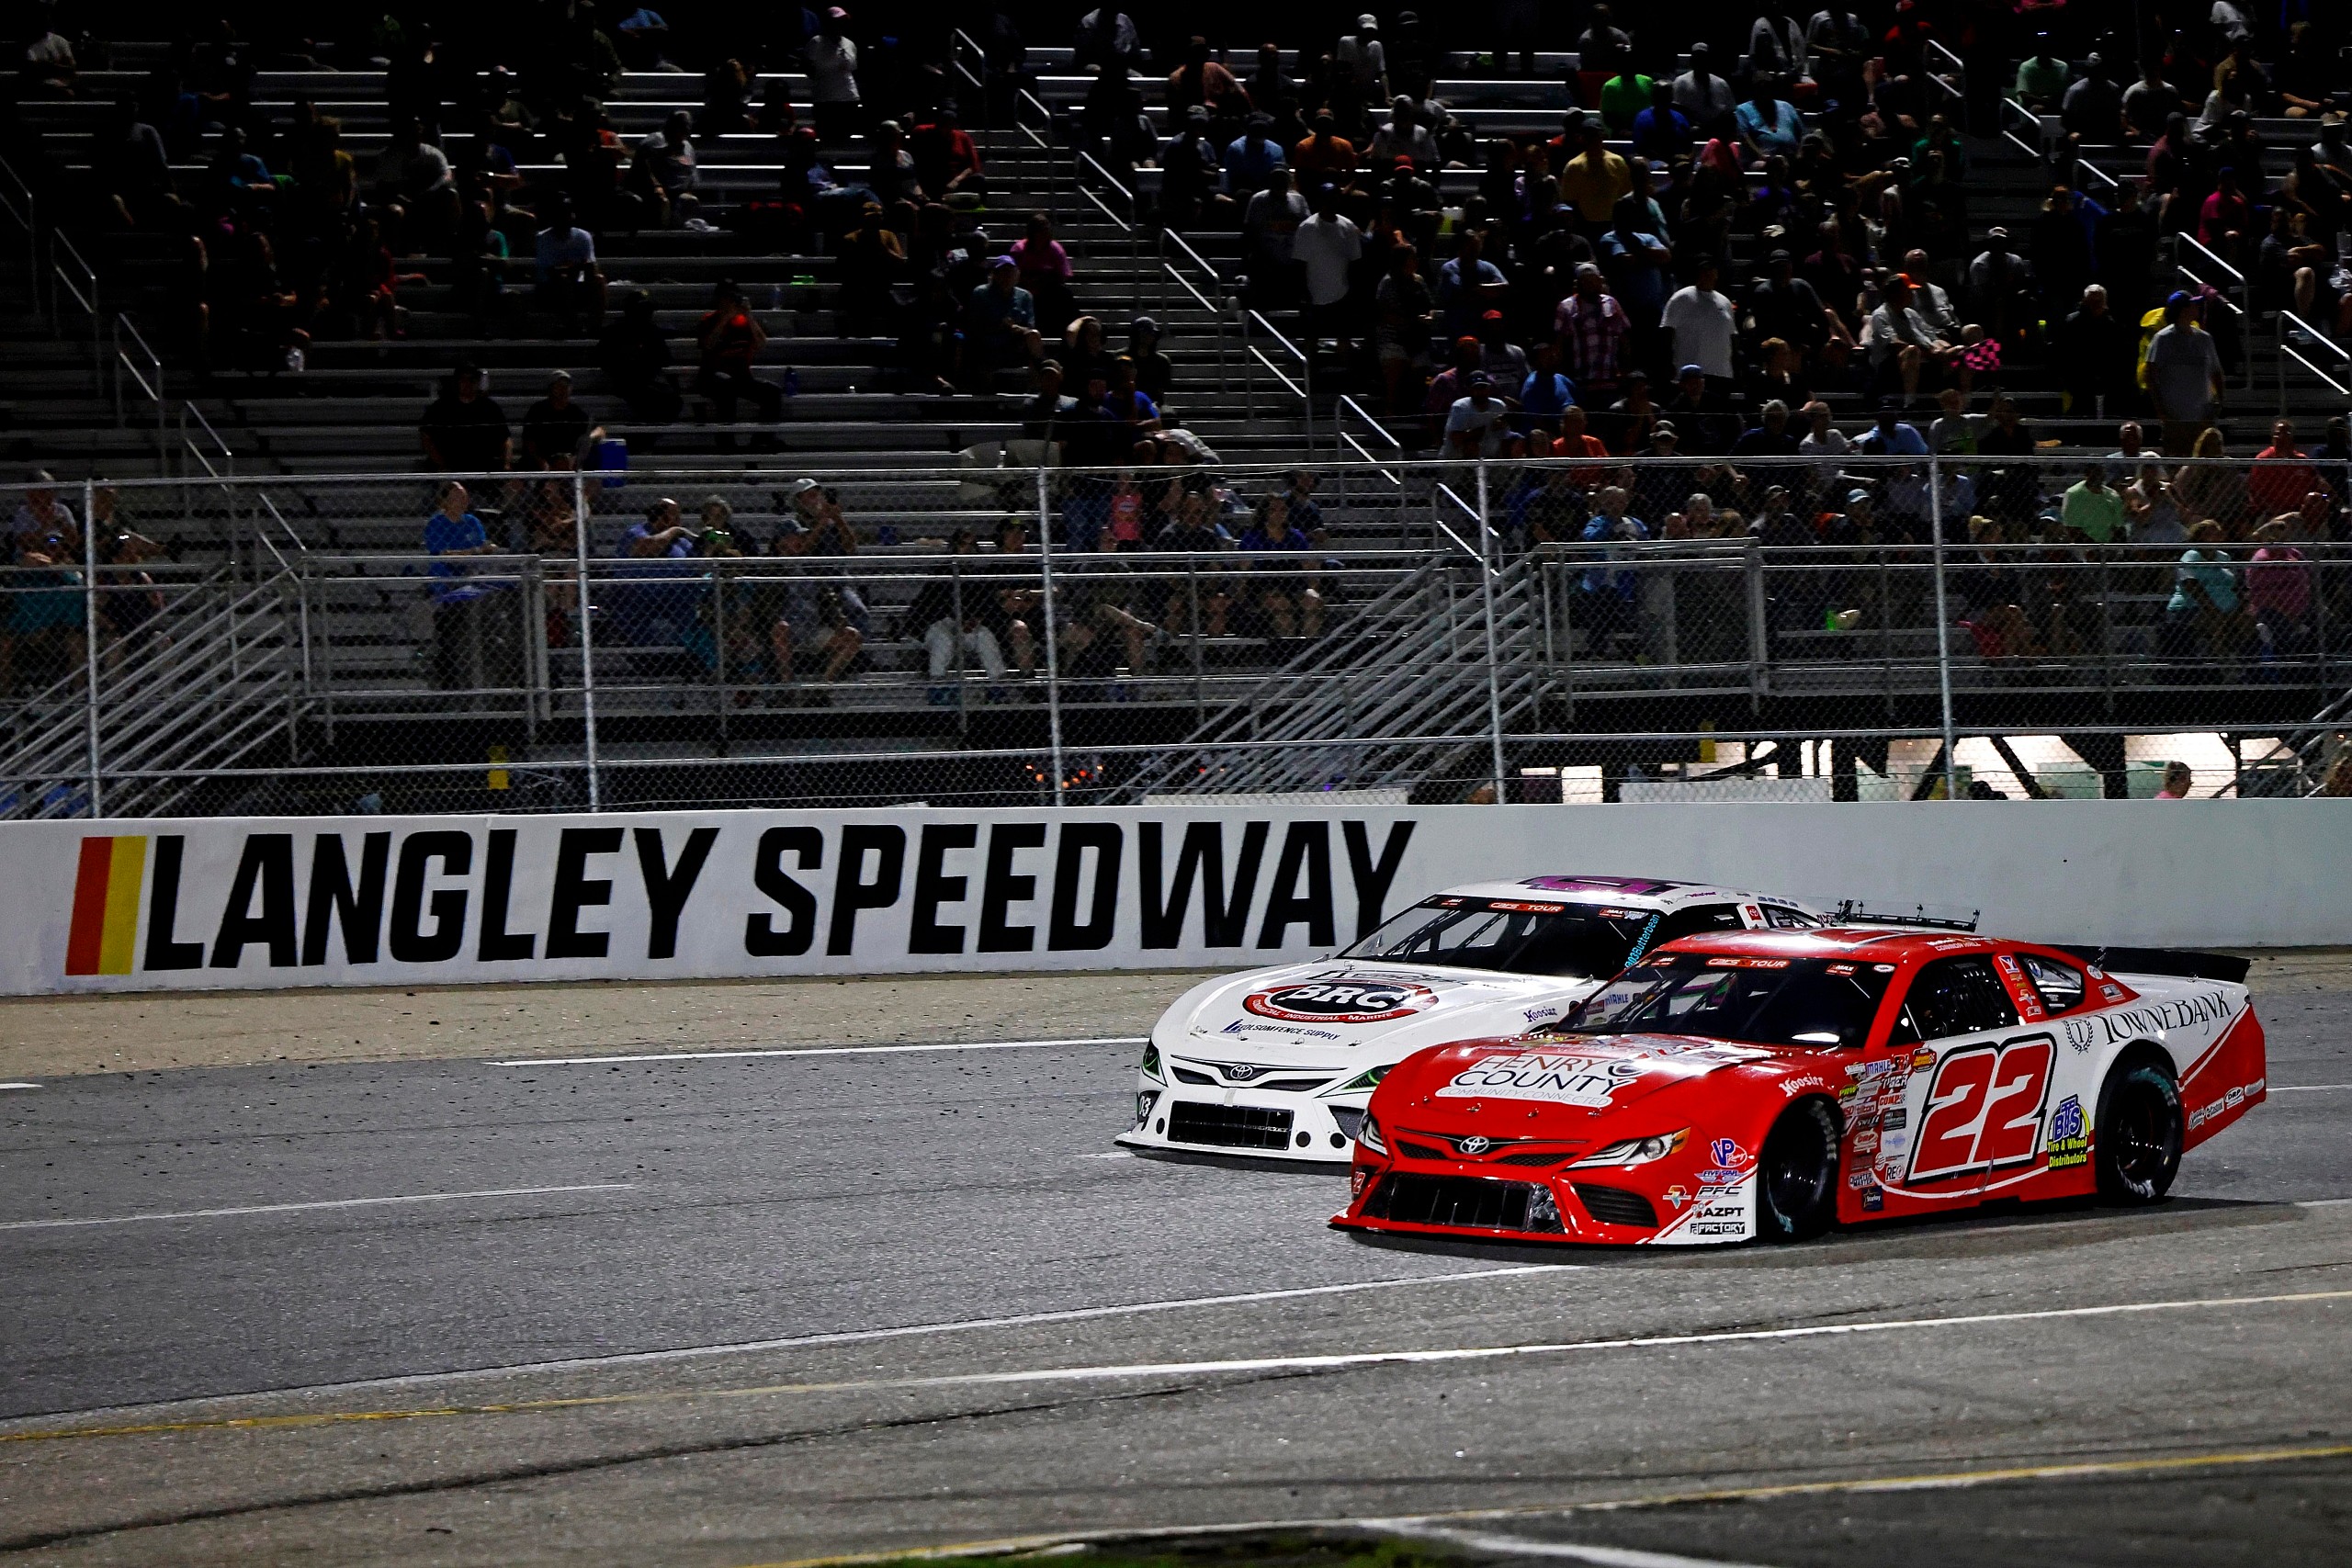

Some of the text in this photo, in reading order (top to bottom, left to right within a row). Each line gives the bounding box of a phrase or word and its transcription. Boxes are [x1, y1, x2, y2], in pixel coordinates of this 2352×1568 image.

[143, 820, 1417, 971] LANGLEY SPEEDWAY
[1527, 905, 1561, 913] TOUR
[1750, 960, 1787, 968] TOUR
[1277, 984, 1408, 1008] BRC
[1348, 1012, 1394, 1021] MARINE
[1523, 1006, 1557, 1022] Hoosier
[1303, 1029, 1340, 1040] SUPPLY
[1475, 1055, 1608, 1072] HENRY
[1867, 1060, 1891, 1075] MAHLE
[1454, 1070, 1629, 1095] COUNTY
[1779, 1073, 1824, 1097] Hoosier
[1440, 1088, 1609, 1105] COMMUNITY CONNECTED
[1911, 1039, 2052, 1179] 22
[1712, 1138, 1736, 1167] VP
[2048, 1136, 2087, 1153] Tire & Wheel
[2049, 1153, 2086, 1168] Distributors
[1699, 1186, 1743, 1195] PFC
[1702, 1207, 1745, 1217] AZPT
[1698, 1223, 1745, 1234] FACTORY
